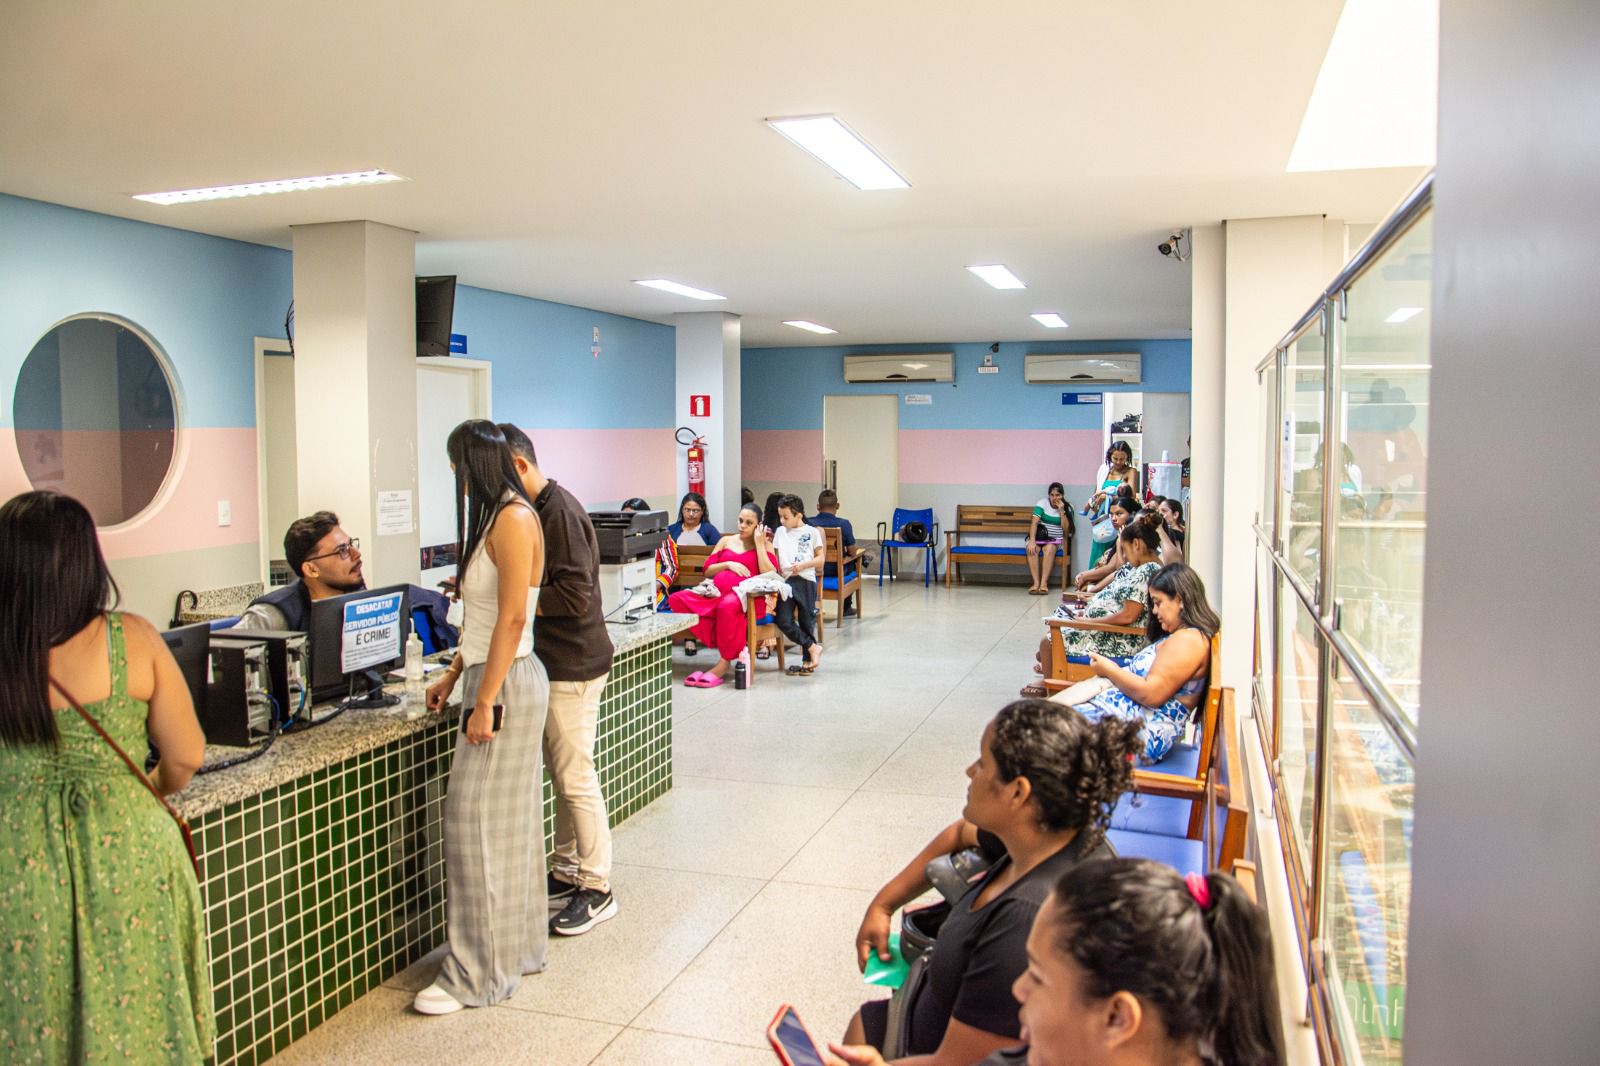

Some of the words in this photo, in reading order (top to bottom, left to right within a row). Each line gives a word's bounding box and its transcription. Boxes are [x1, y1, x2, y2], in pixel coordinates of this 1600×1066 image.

[356, 599, 392, 615] DESACATAR
[344, 616, 377, 631] SERVIDOR
[363, 627, 391, 644] CRIME
